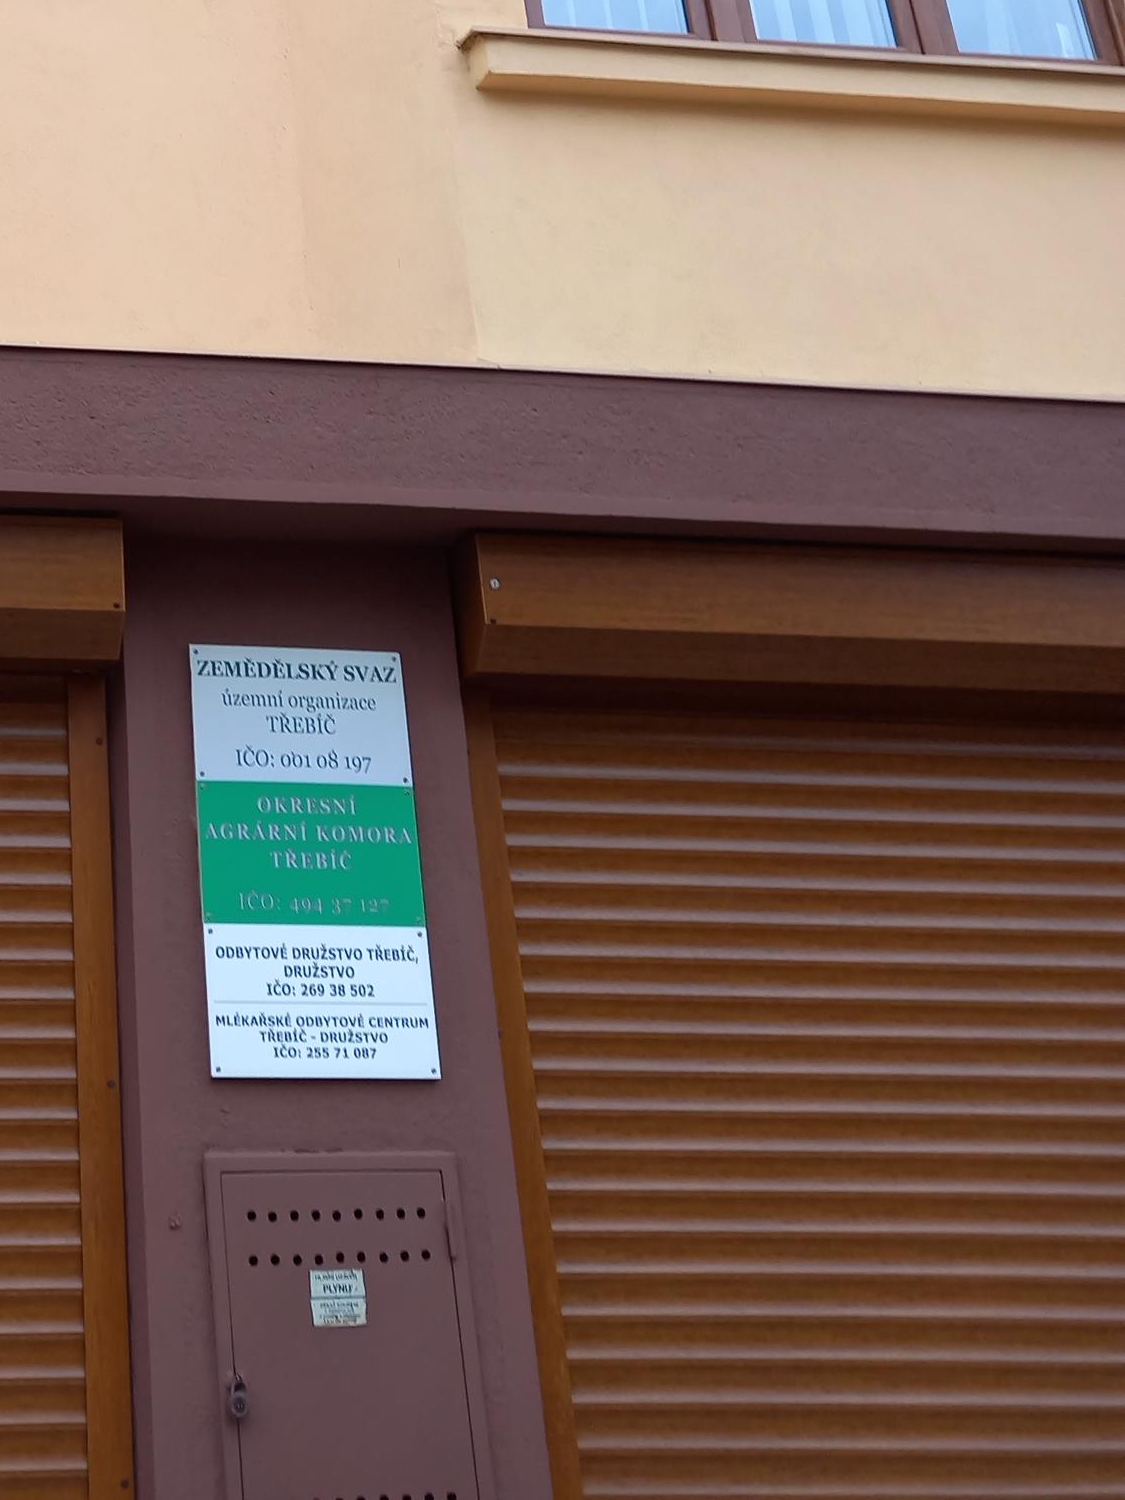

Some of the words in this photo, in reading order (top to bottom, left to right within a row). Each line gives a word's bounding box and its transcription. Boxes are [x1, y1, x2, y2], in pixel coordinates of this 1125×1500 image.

[197, 658, 339, 681] ZEMĚDĚLSKÝ
[344, 665, 397, 684] SVAZ
[222, 688, 283, 707] územní
[288, 691, 377, 712] organizace
[266, 714, 337, 735] TŘEBÍČ
[236, 746, 275, 768] IČO:
[344, 756, 371, 774] 197
[257, 795, 357, 815] OKRESNÍ
[205, 821, 307, 841] AGRÁRNÍ
[316, 825, 412, 844] KOMORA
[270, 850, 352, 870] TŘEBÍČ
[215, 943, 288, 960] ODBYTOVÉ
[292, 944, 363, 960] DRUŽSTVO
[367, 946, 419, 964] TŘEBÍČ,
[284, 962, 355, 979] DRUŽSTVO
[266, 980, 296, 997] IČO:
[301, 984, 325, 997] 269
[330, 984, 346, 997] 38
[350, 984, 375, 997] 502
[215, 1012, 291, 1027] MLÉKAŘSKÉ
[296, 1013, 364, 1028] ODBYTOVÉ
[369, 1017, 429, 1029] CENTRUM
[259, 1028, 307, 1042] TŘEBÍČ
[321, 1029, 388, 1043] DRUŽSTVO
[273, 1042, 301, 1058] IČO:
[306, 1047, 329, 1058] 255
[334, 1048, 349, 1058] 71
[354, 1048, 377, 1059] 087
